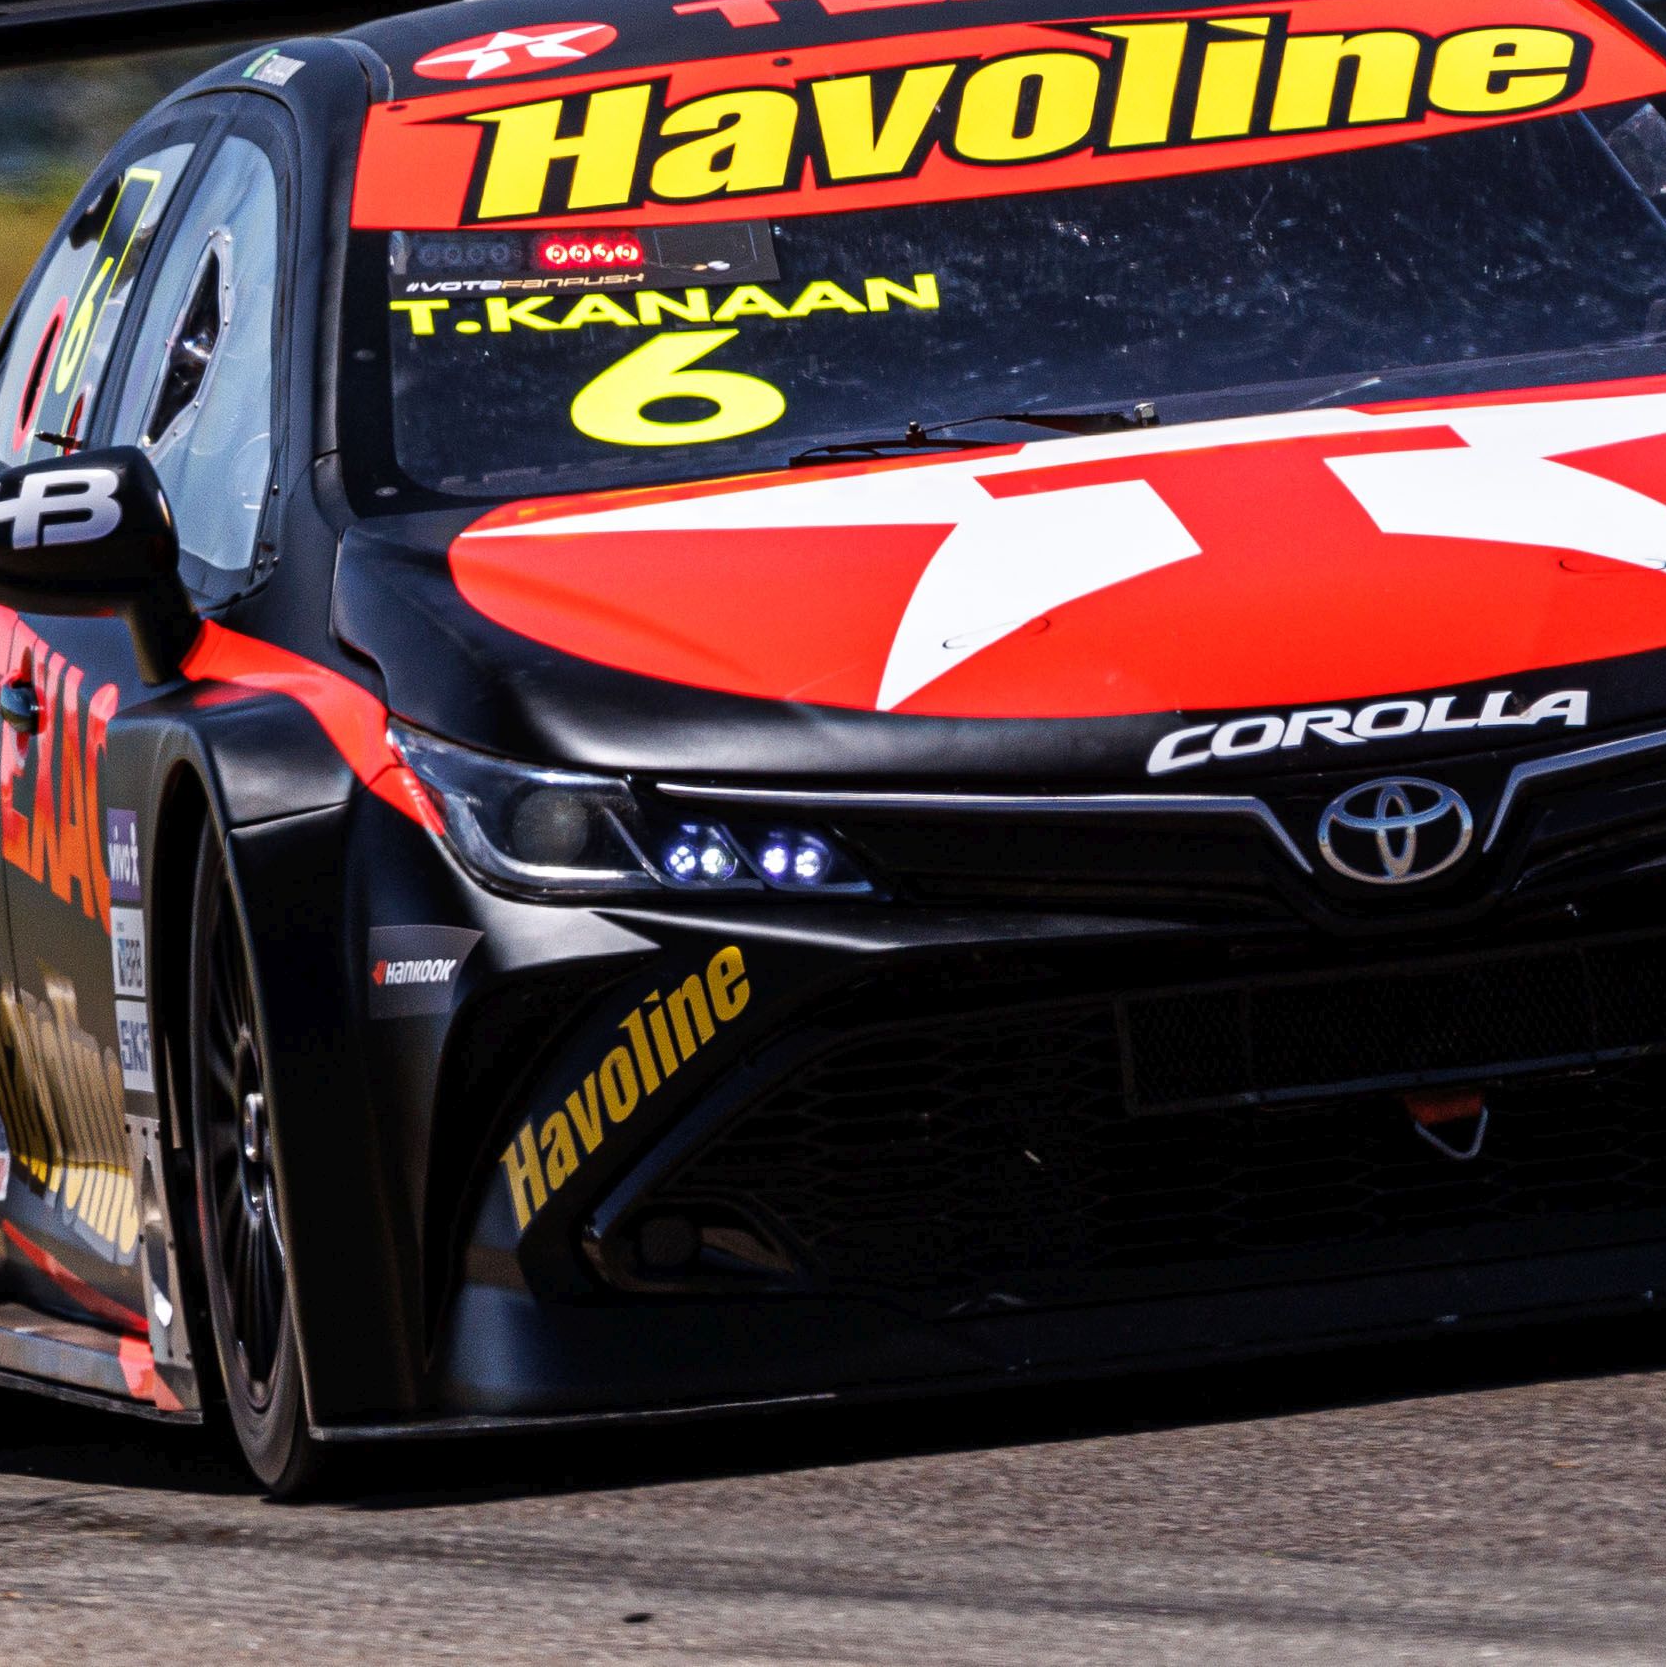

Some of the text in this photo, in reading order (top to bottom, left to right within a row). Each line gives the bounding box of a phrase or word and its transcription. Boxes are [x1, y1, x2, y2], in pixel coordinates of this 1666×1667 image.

[467, 18, 1574, 218] Havoline
[390, 274, 939, 336] T.KANAAN
[571, 329, 785, 446] 6
[1146, 690, 1589, 776] COROLLA
[500, 945, 752, 1230] Havoline
